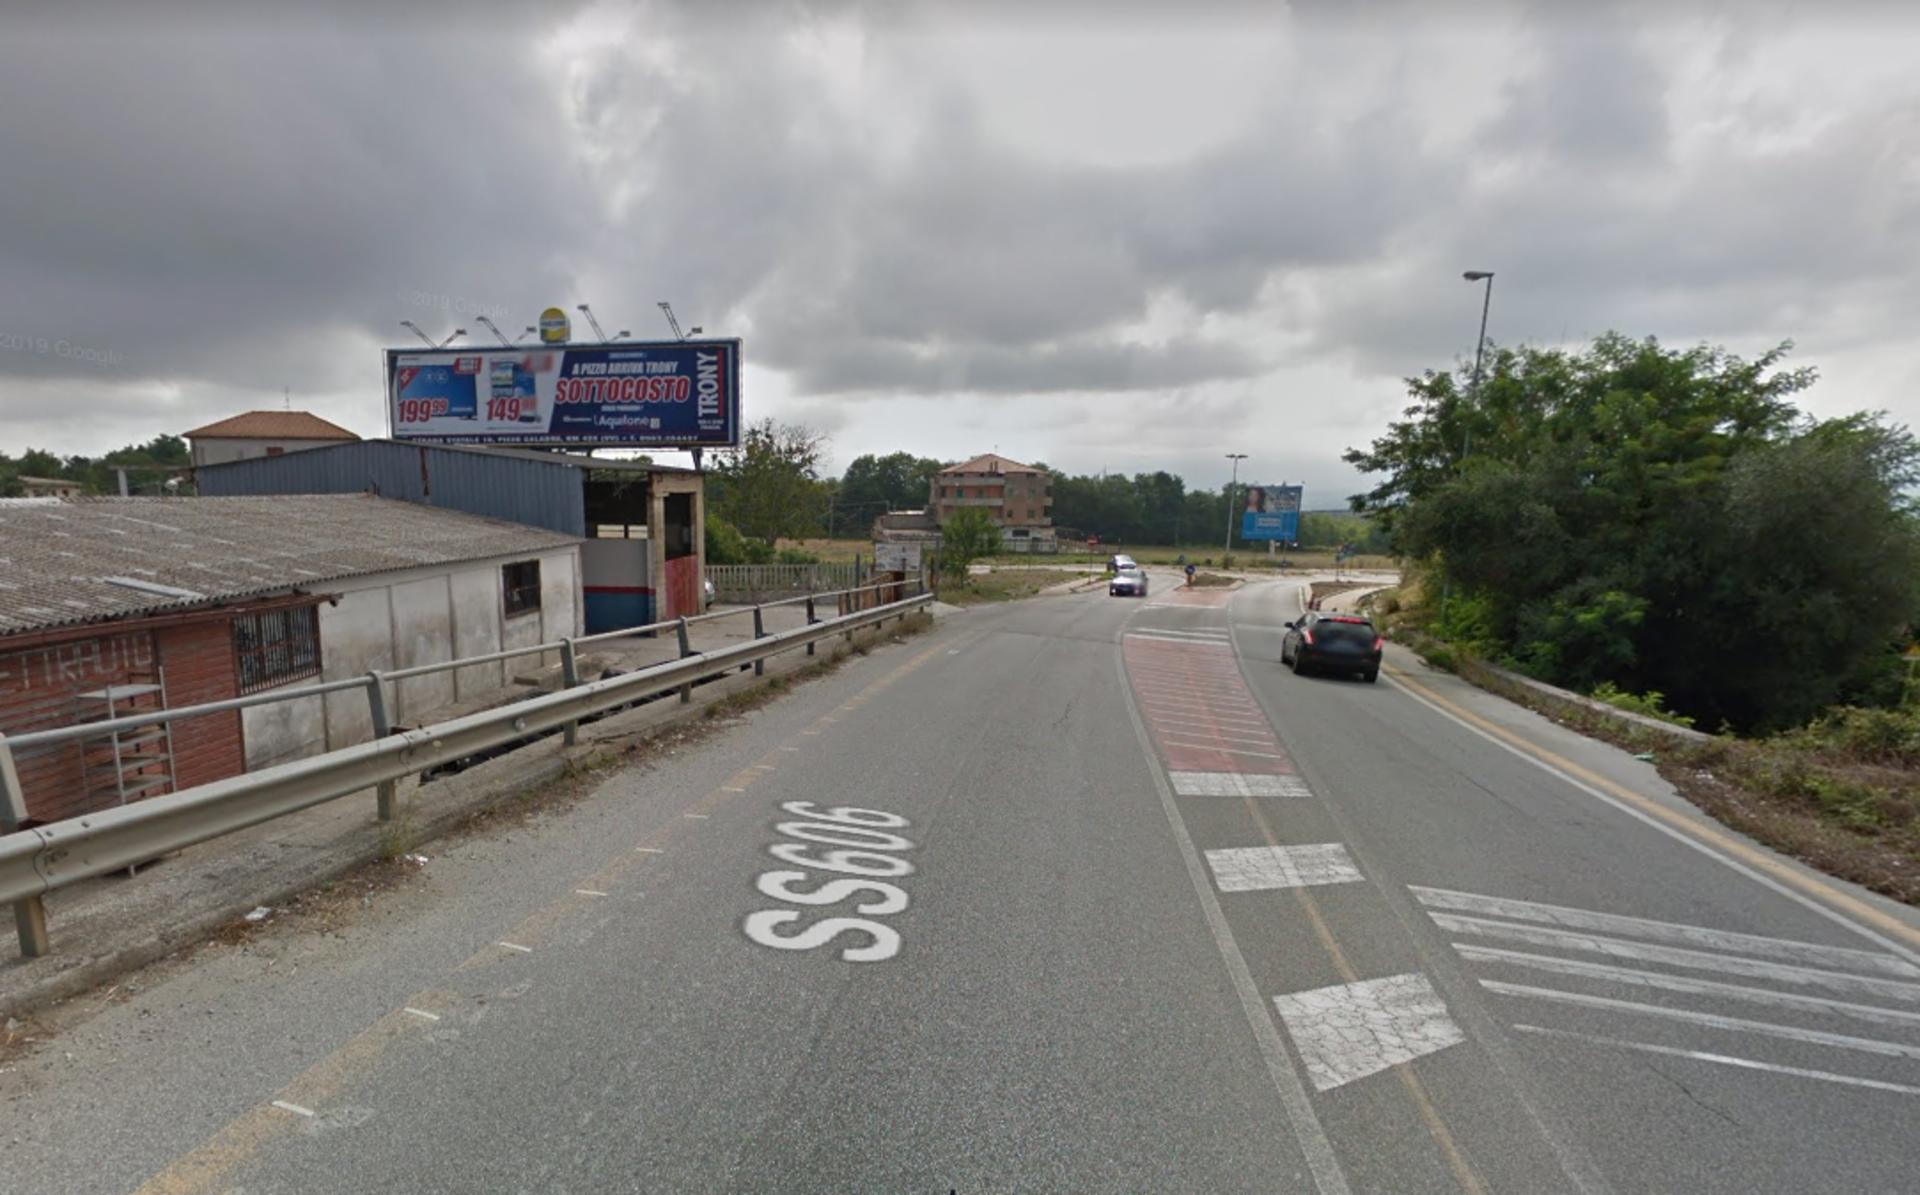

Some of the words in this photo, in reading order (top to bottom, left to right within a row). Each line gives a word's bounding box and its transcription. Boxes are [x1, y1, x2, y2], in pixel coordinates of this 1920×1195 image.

[572, 362, 579, 375] A
[581, 362, 606, 375] PIZZO
[608, 361, 643, 374] ARRIVA
[645, 361, 678, 374] TRONY
[555, 375, 690, 404] SOTTOCOSTO
[697, 352, 719, 417] TRONY
